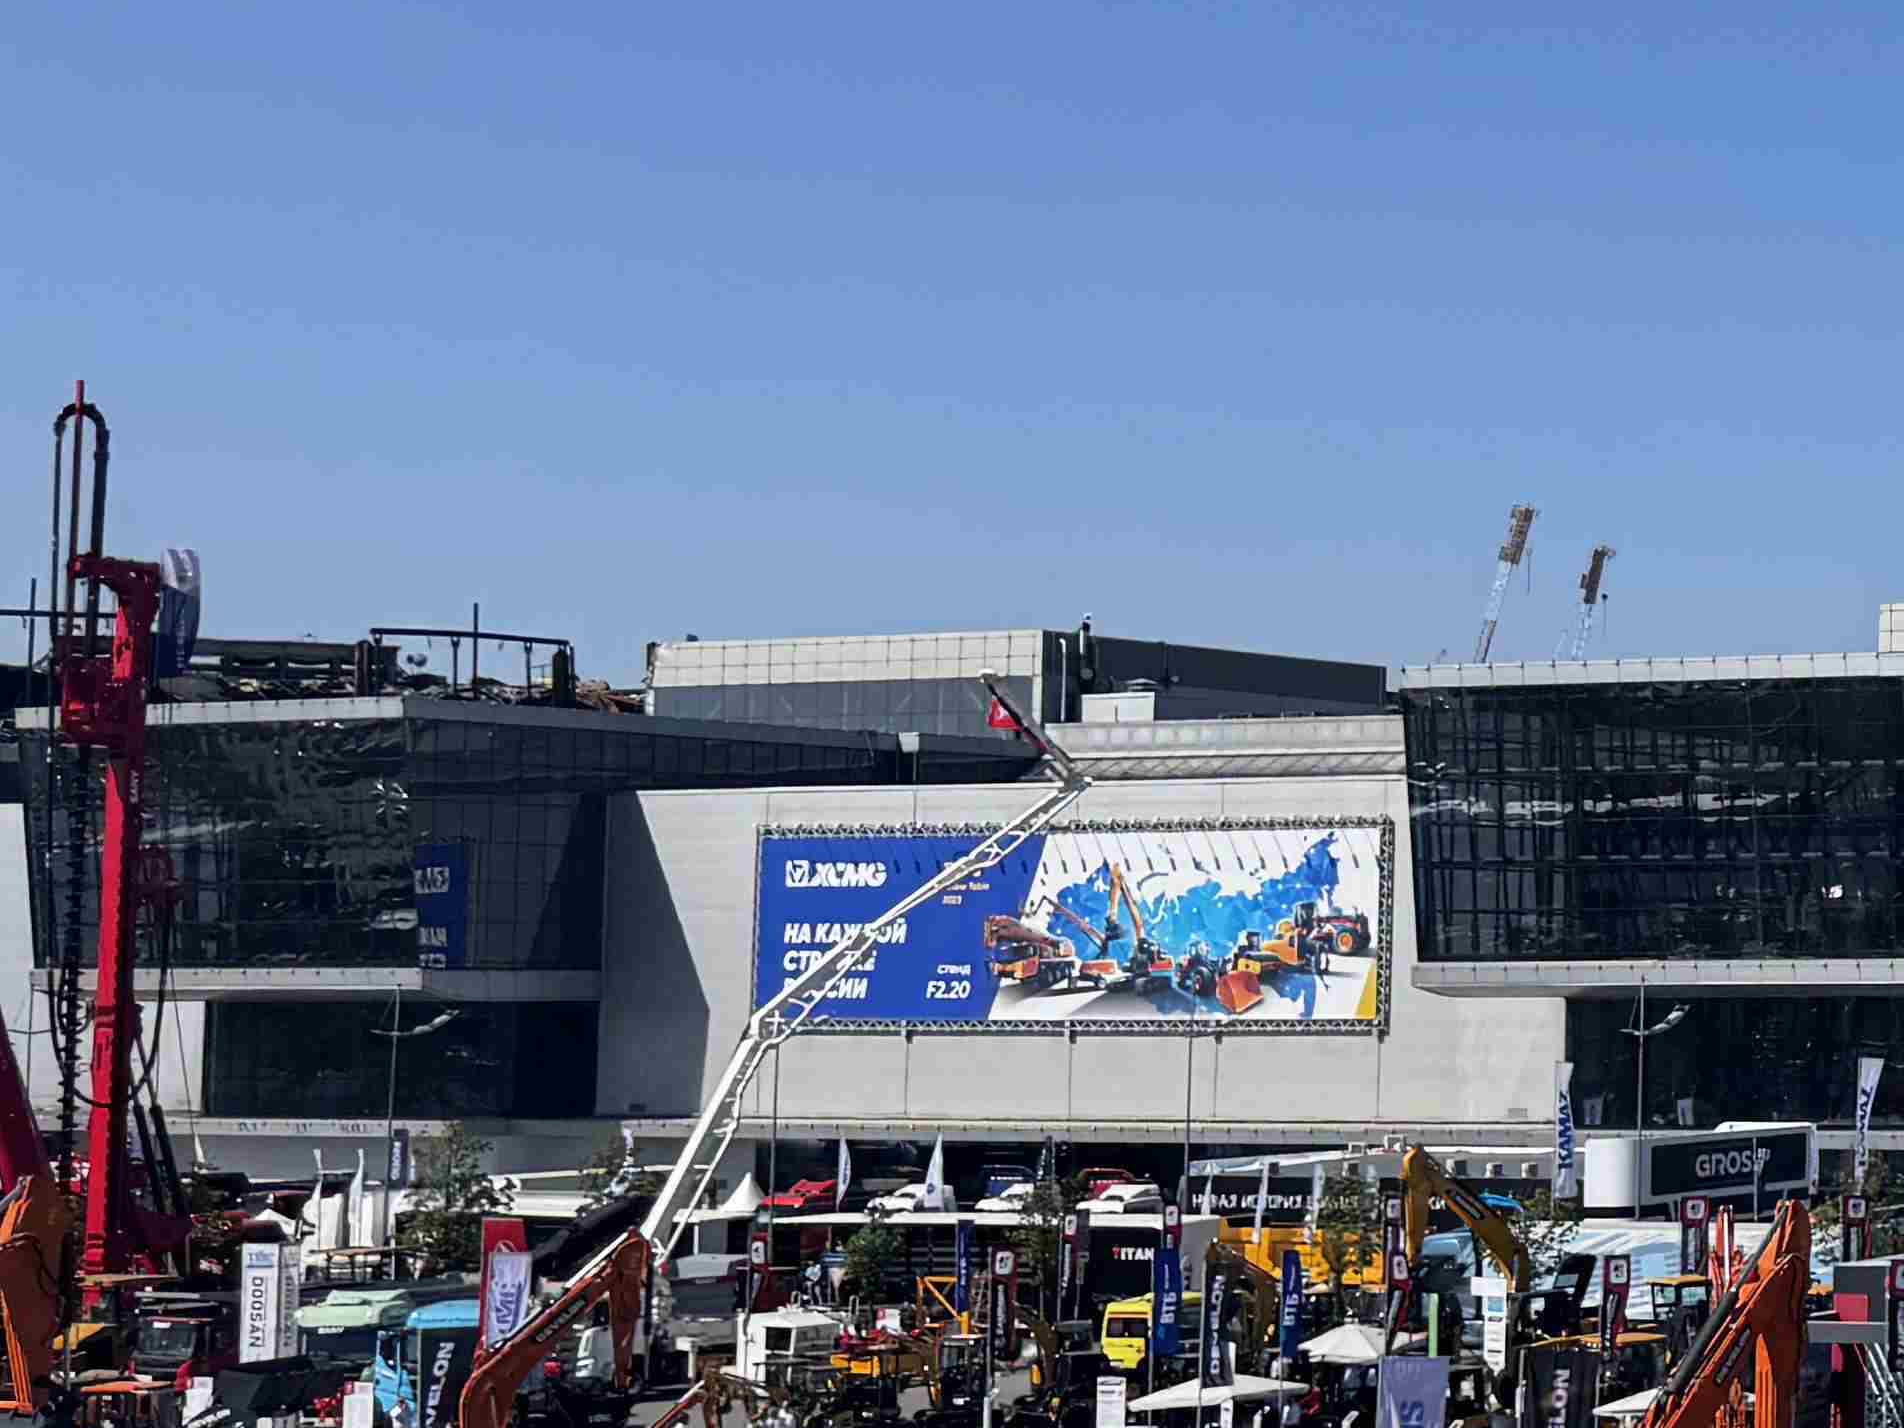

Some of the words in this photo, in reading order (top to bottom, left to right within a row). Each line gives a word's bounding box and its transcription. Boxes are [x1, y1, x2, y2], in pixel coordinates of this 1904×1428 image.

[818, 860, 887, 886] XCMG
[784, 924, 811, 943] НА
[815, 919, 907, 943] КАЖОЙ
[927, 980, 970, 998] F2.20
[1556, 1089, 1574, 1170] KAMAZ
[1192, 1194, 1237, 1209] НВАЯ
[1113, 1247, 1154, 1261] TITAN
[249, 1276, 264, 1348] DOOSAN
[1160, 1291, 1177, 1325] ВТБ
[1209, 1274, 1225, 1375] DEVELON
